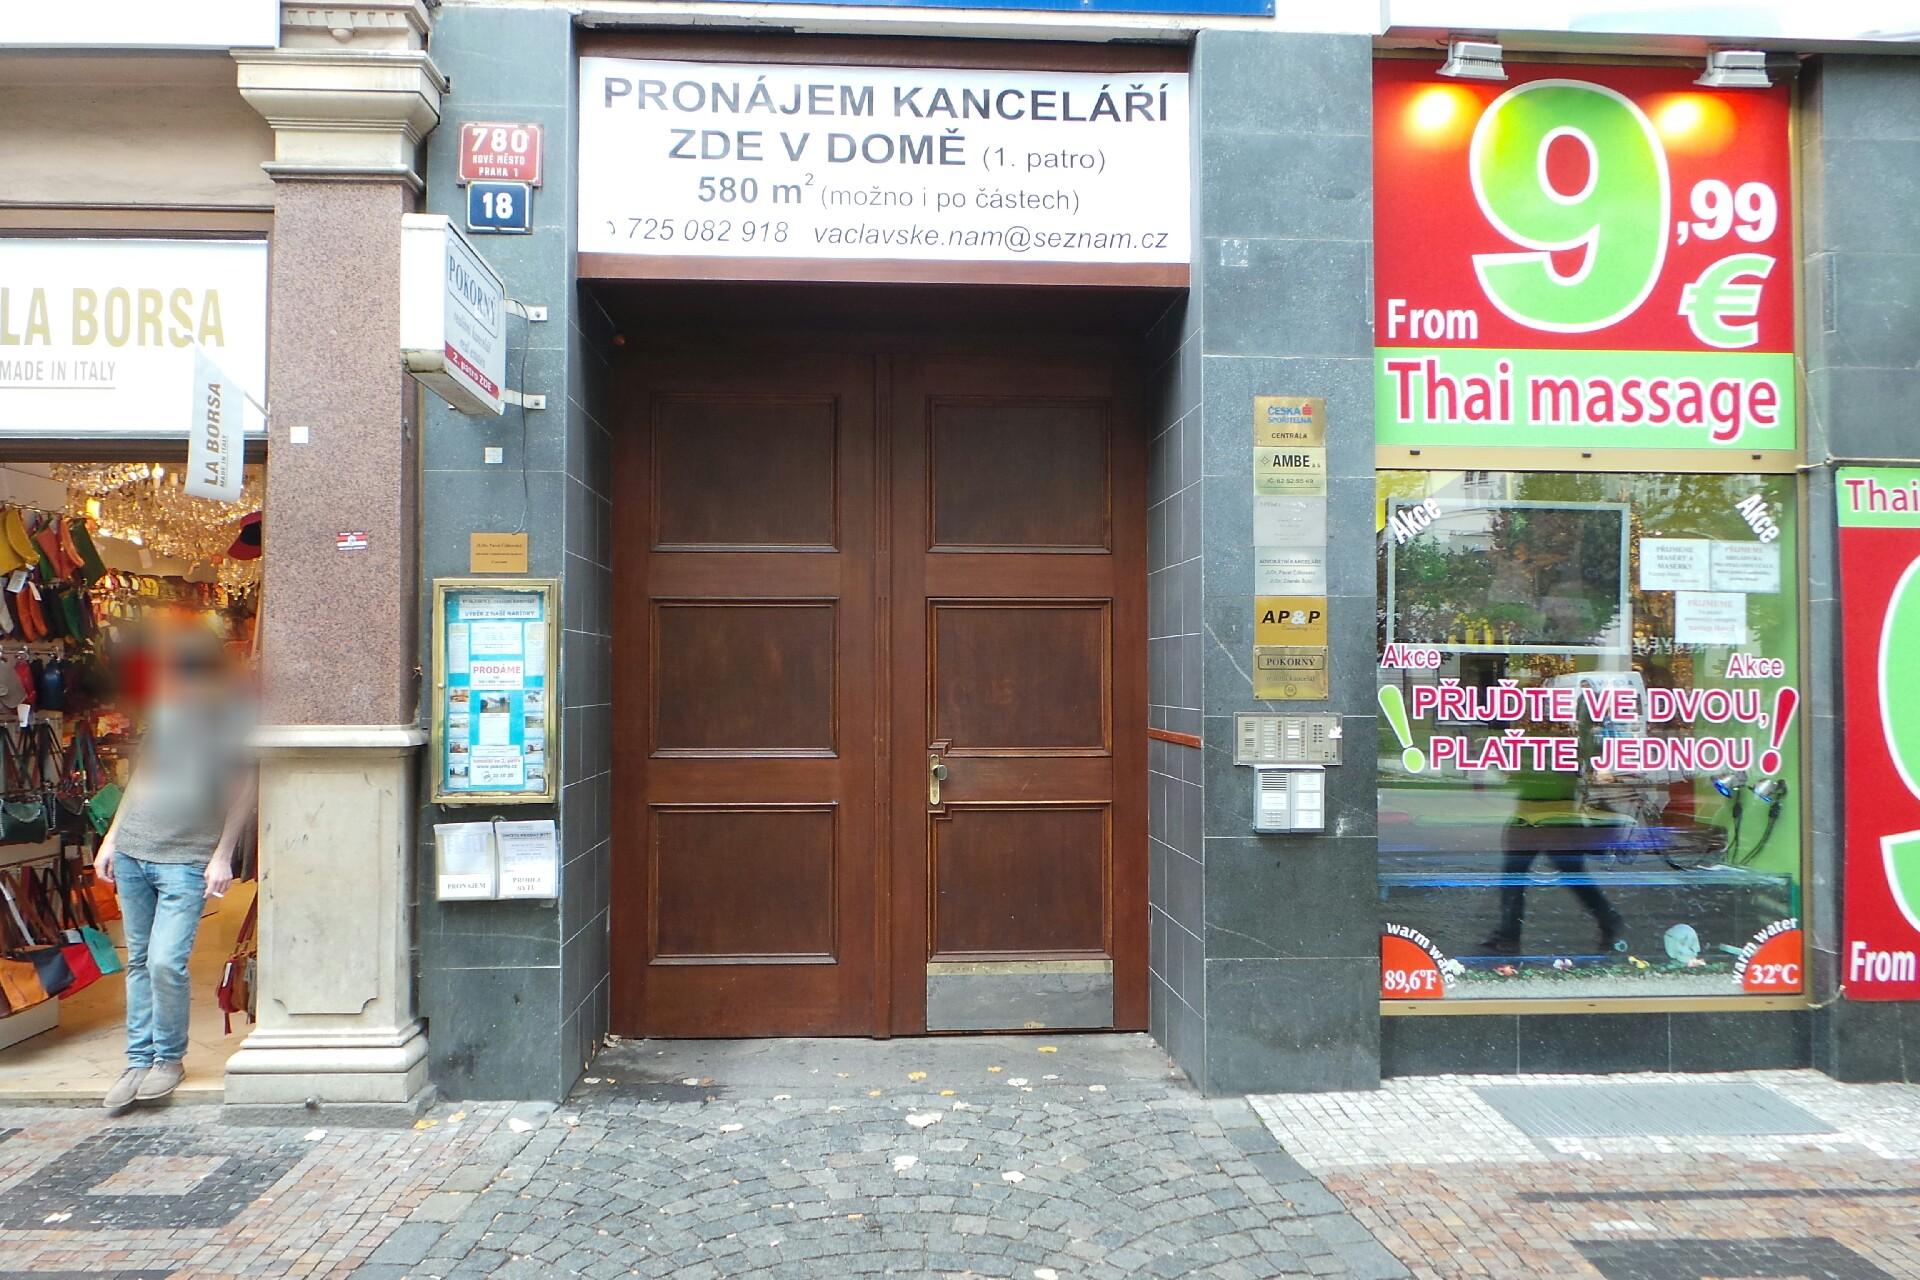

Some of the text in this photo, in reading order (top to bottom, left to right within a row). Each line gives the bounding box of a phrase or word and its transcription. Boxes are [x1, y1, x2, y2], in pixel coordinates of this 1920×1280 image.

[604, 75, 1168, 123] PRONÁJEM KANCELÁŘÍ
[471, 128, 529, 153] 780
[472, 153, 526, 165] NOVÉ MĚSTO
[669, 128, 1105, 174] ZDE V DOMĚ (1. patro)
[479, 167, 519, 177] PRAHA 1
[482, 191, 514, 219] 18
[698, 176, 758, 203] 580
[821, 186, 913, 210] (možno
[922, 187, 927, 207] i
[937, 191, 966, 212] po
[976, 188, 1080, 215] částech)
[628, 218, 1168, 252] 725 082 918 vaclavske.nam@seznam.cz
[449, 255, 496, 327] POKORNÝ
[1386, 299, 1479, 339] From
[1678, 252, 1777, 349] €
[1, 286, 225, 347] LA BORSA
[0, 360, 116, 381] MADE IN ITALY
[1386, 357, 1779, 442] Thai massage
[204, 383, 221, 487] LA BORSA
[1272, 454, 1310, 468] AMBE
[1843, 478, 1920, 512] Thai
[1389, 498, 1441, 545] Akce
[1735, 493, 1781, 544] Akce
[1261, 609, 1321, 625] AP&P
[1382, 644, 1440, 668] Akce
[1728, 654, 1784, 677] Akce
[1413, 680, 1576, 721] PŘIJĎTE
[1581, 688, 1639, 721] VE
[1648, 688, 1768, 727] DVOU,
[1431, 730, 1752, 771] PLAŤTE JEDNOU
[1386, 922, 1456, 989] warm water
[1731, 917, 1799, 985] warm water
[1849, 940, 1917, 982] From
[1384, 969, 1437, 993] 89,6°F
[1749, 963, 1799, 985] 32°C
